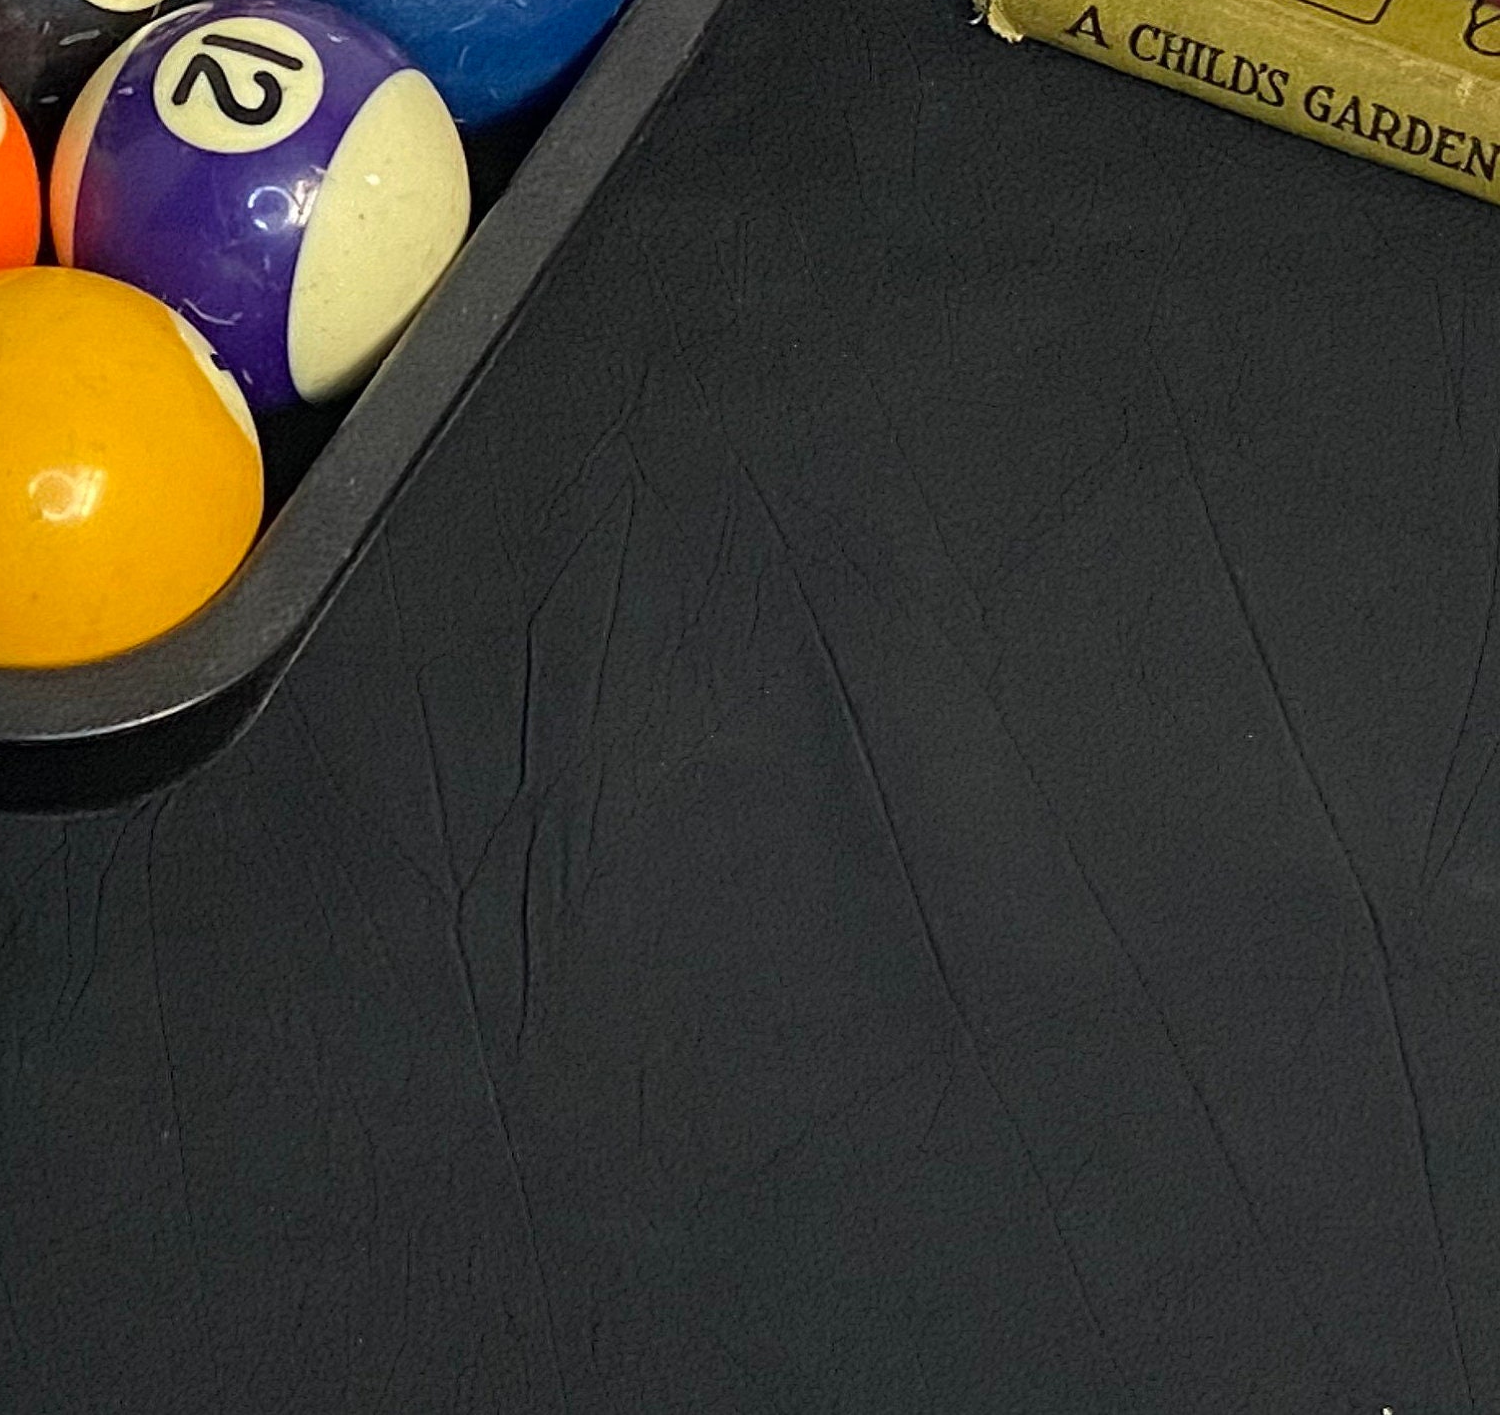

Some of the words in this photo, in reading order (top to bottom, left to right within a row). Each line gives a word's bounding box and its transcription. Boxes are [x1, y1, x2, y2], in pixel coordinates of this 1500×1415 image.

[171, 34, 304, 126] 12
[1063, 4, 1110, 49] A
[1128, 23, 1290, 108] CHILD'S
[1303, 84, 1500, 182] GARDEN
